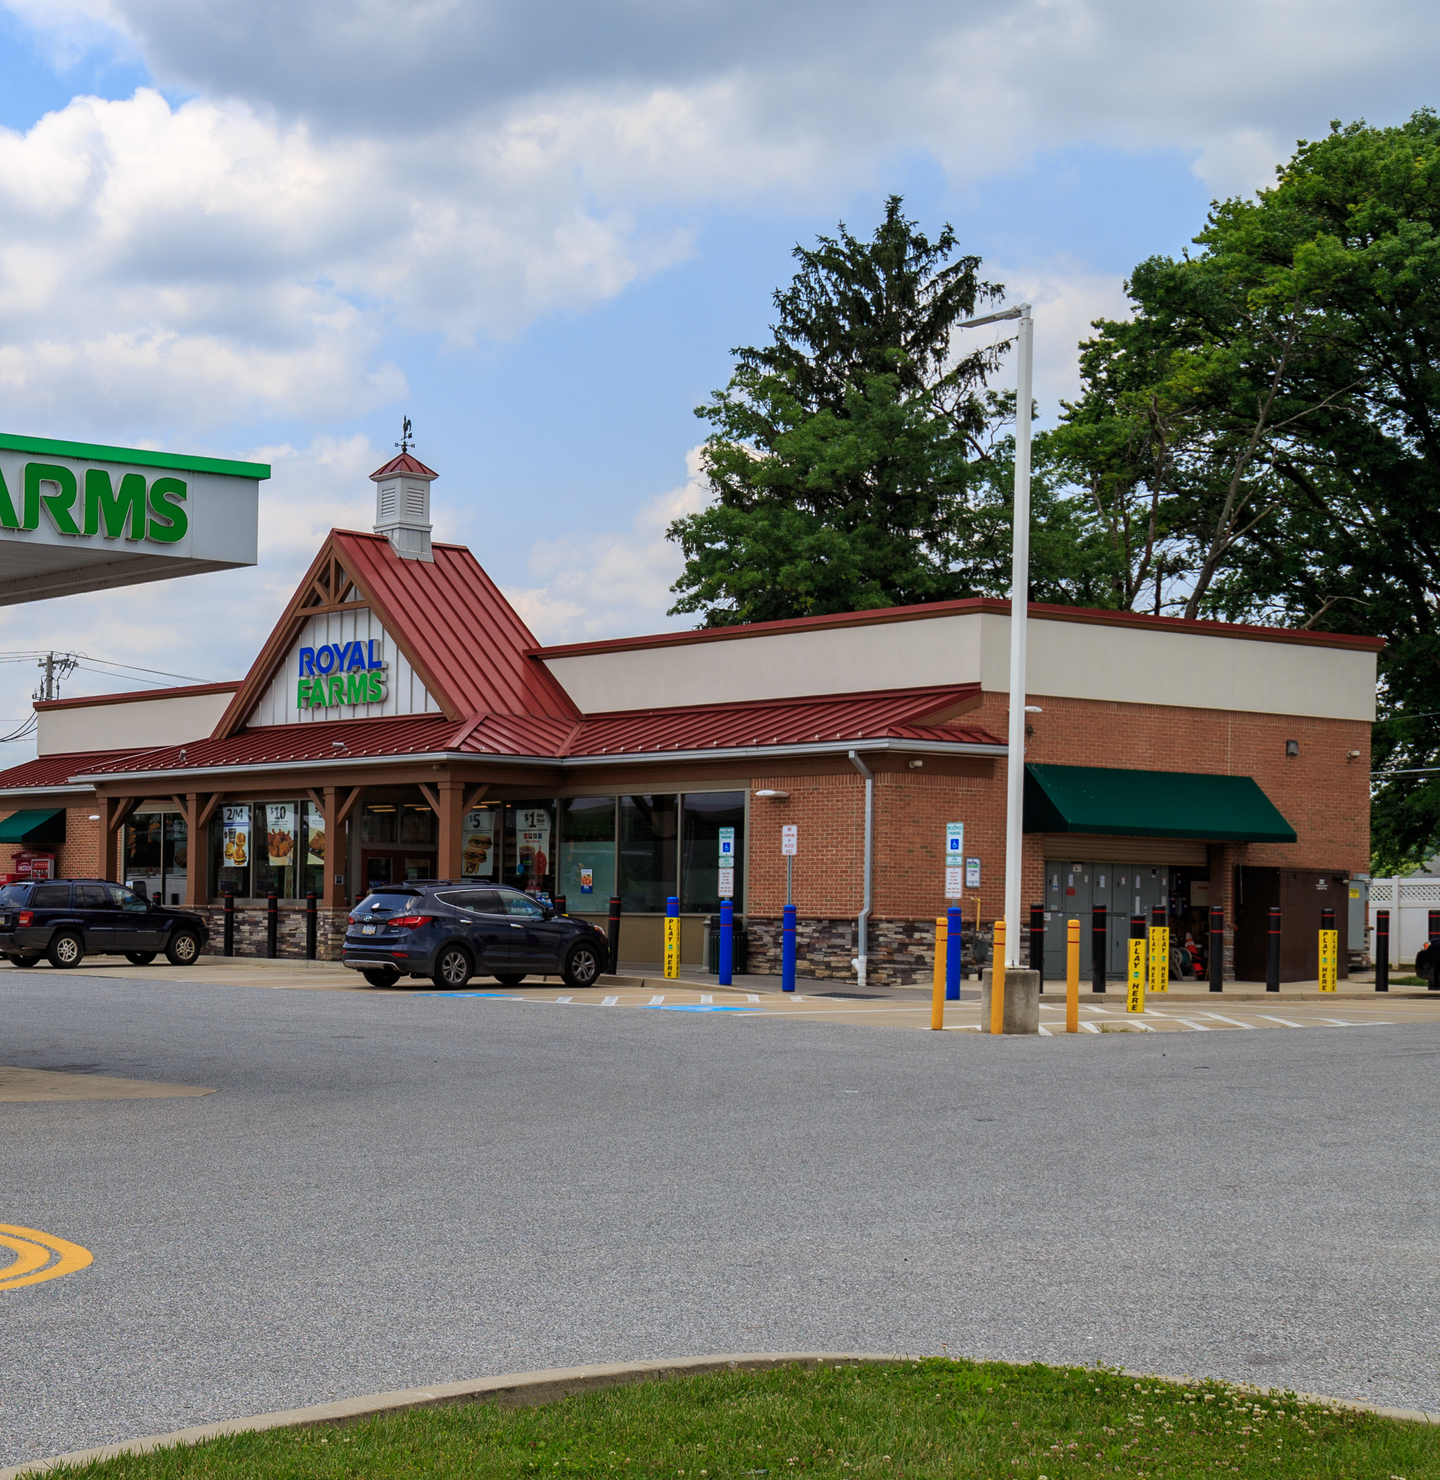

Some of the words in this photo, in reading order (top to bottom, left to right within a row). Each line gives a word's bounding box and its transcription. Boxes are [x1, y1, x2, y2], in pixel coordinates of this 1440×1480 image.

[298, 638, 384, 678] ROYAL
[296, 671, 383, 709] FARMS
[226, 808, 244, 821] 2/$4
[270, 806, 287, 820] $10
[468, 813, 481, 829] $5
[523, 811, 537, 828] $1
[1133, 940, 1141, 969] PLAY
[1131, 983, 1139, 1011] HERE
